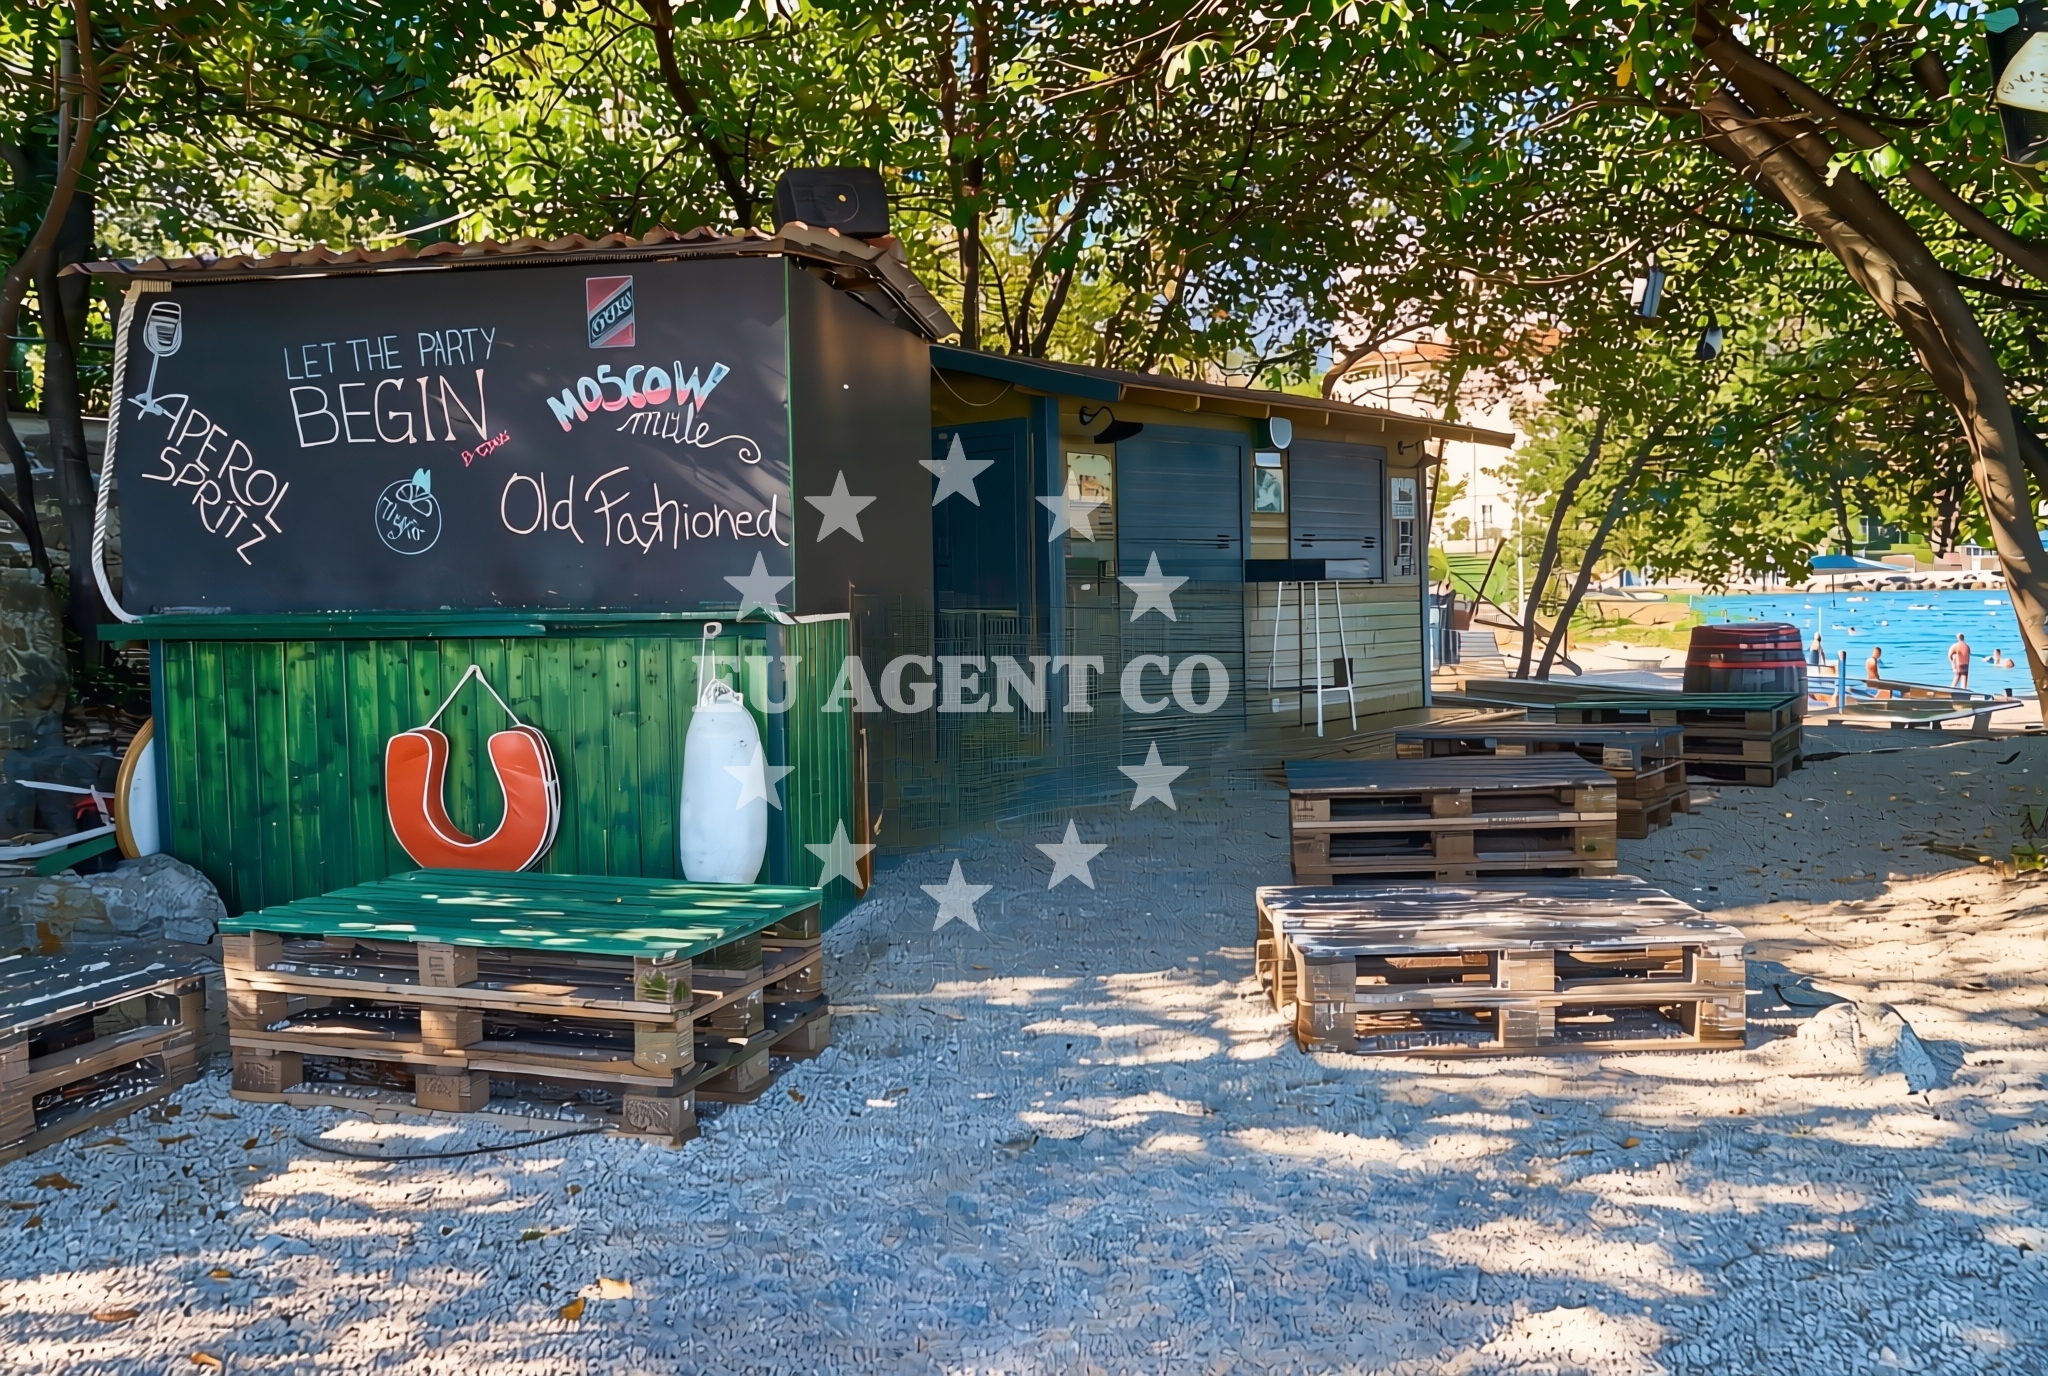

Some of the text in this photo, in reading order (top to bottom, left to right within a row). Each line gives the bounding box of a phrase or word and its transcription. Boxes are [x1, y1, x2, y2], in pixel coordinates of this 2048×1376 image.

[284, 327, 496, 380] LET THE PARTY
[289, 369, 488, 448] BEGIN
[547, 360, 730, 432] MOSCOW
[127, 394, 289, 534] APEROL
[142, 446, 267, 565] SPRITZ
[501, 472, 584, 543] Old
[584, 466, 789, 554] Fashioned
